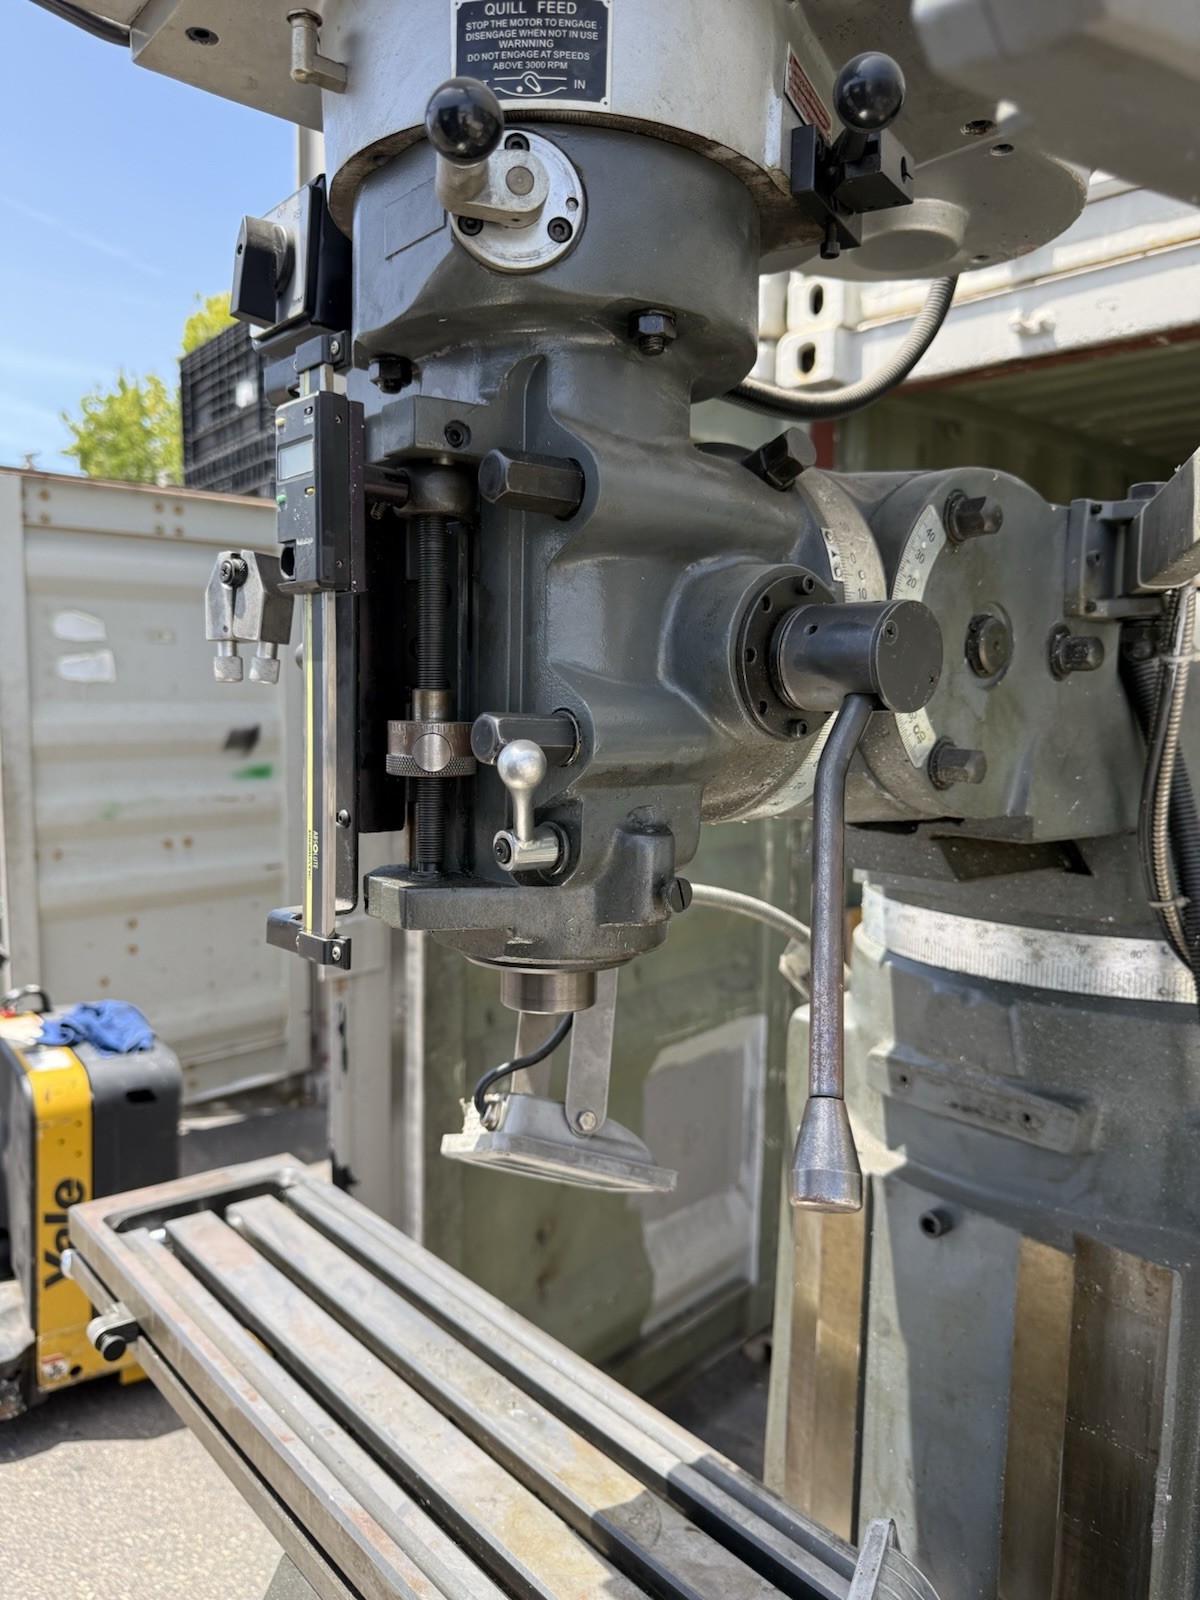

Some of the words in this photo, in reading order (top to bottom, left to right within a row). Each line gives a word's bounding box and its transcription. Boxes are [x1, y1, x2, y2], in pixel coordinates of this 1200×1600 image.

[485, 2, 527, 16] QUILL
[537, 1, 577, 15] FEED
[465, 20, 489, 31] STOP
[491, 19, 508, 28] THE
[509, 18, 543, 27] MOTOR
[545, 18, 557, 27] TO
[558, 19, 597, 30] ENGAGE
[465, 29, 517, 41] DISENGAGE
[519, 28, 547, 38] WHEN
[548, 29, 567, 38] NOT
[569, 30, 579, 39] IN
[580, 31, 599, 40] USE
[498, 39, 554, 49] WARNNING
[467, 53, 480, 62] DO
[481, 51, 500, 61] NOT
[501, 50, 539, 60] ENGAGE
[540, 50, 552, 59] AT
[553, 51, 590, 60] SPEEDS
[493, 61, 524, 71] ABOVE
[525, 61, 546, 69] 3000
[547, 61, 568, 70] RPM
[574, 80, 586, 90] IN
[926, 528, 936, 543] 40
[915, 549, 925, 564] 30
[906, 574, 917, 589] 20
[858, 587, 868, 600] 10
